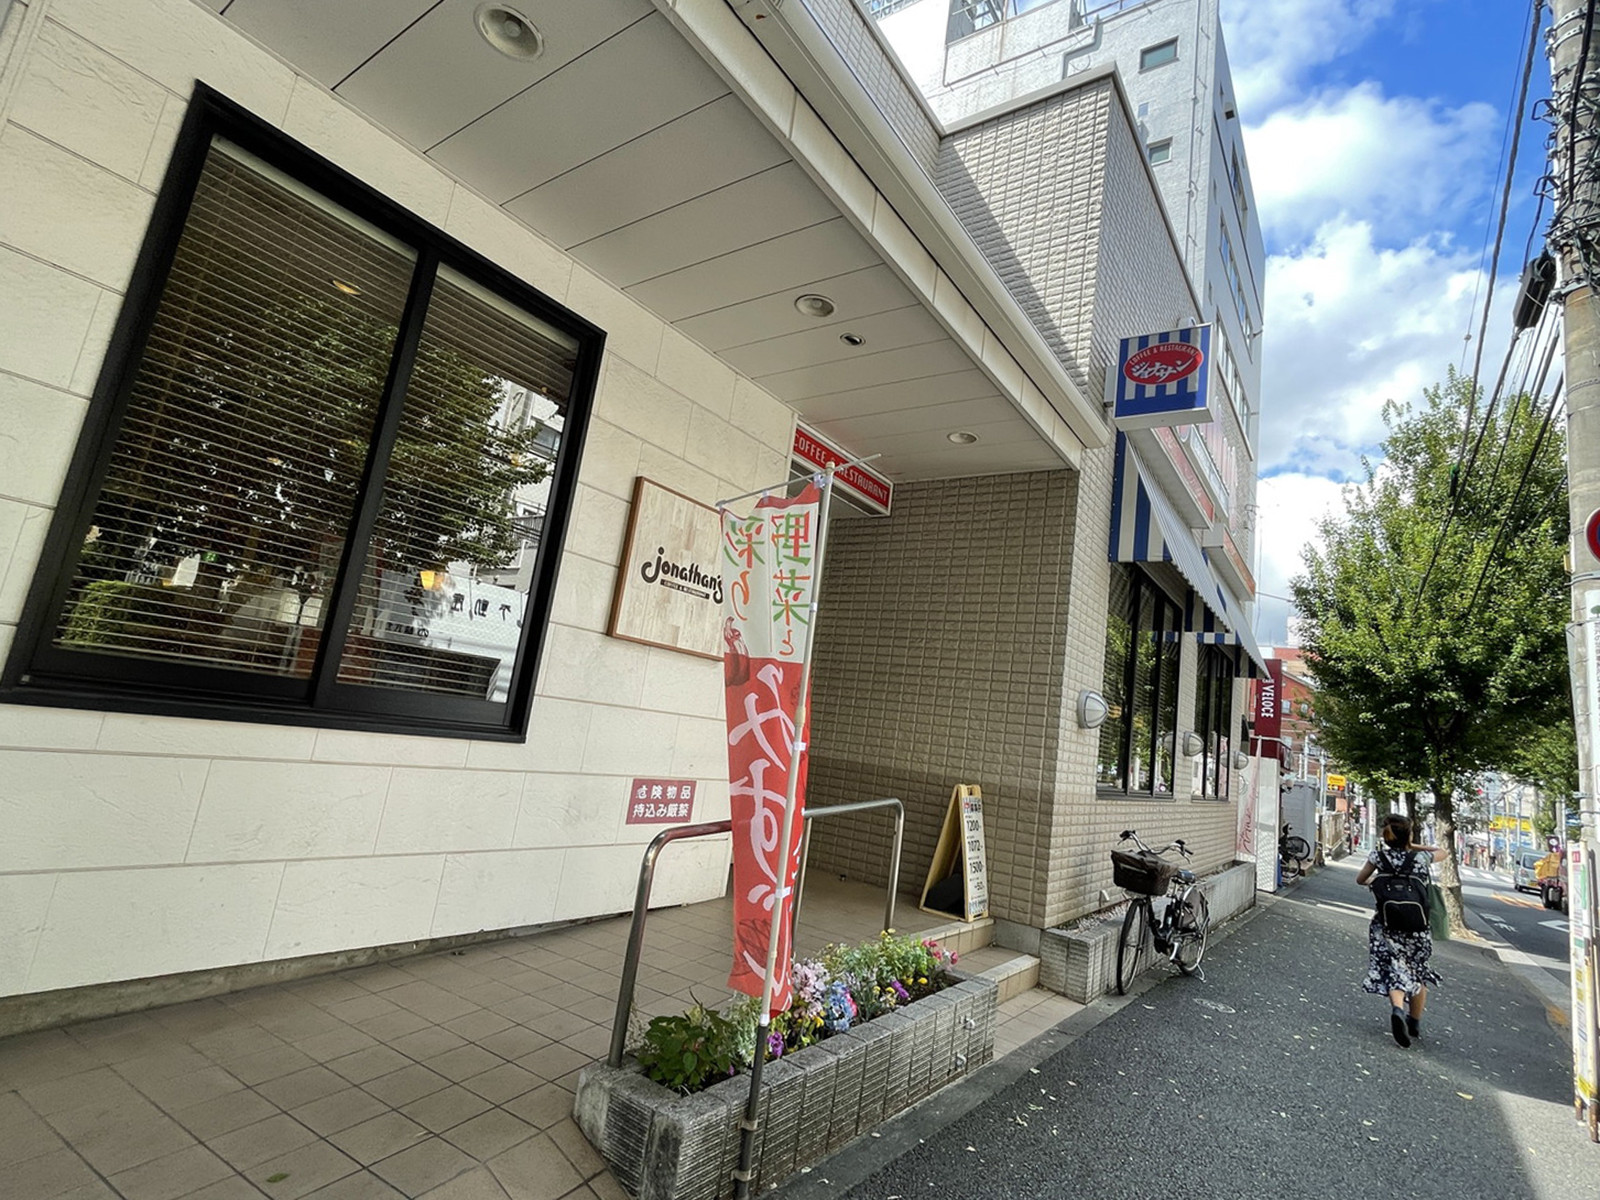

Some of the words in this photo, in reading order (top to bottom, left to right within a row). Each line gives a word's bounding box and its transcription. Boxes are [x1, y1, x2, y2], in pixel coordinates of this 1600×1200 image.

[1261, 685, 1275, 718] VELOCE
[632, 802, 690, 818] 持込み厳禁
